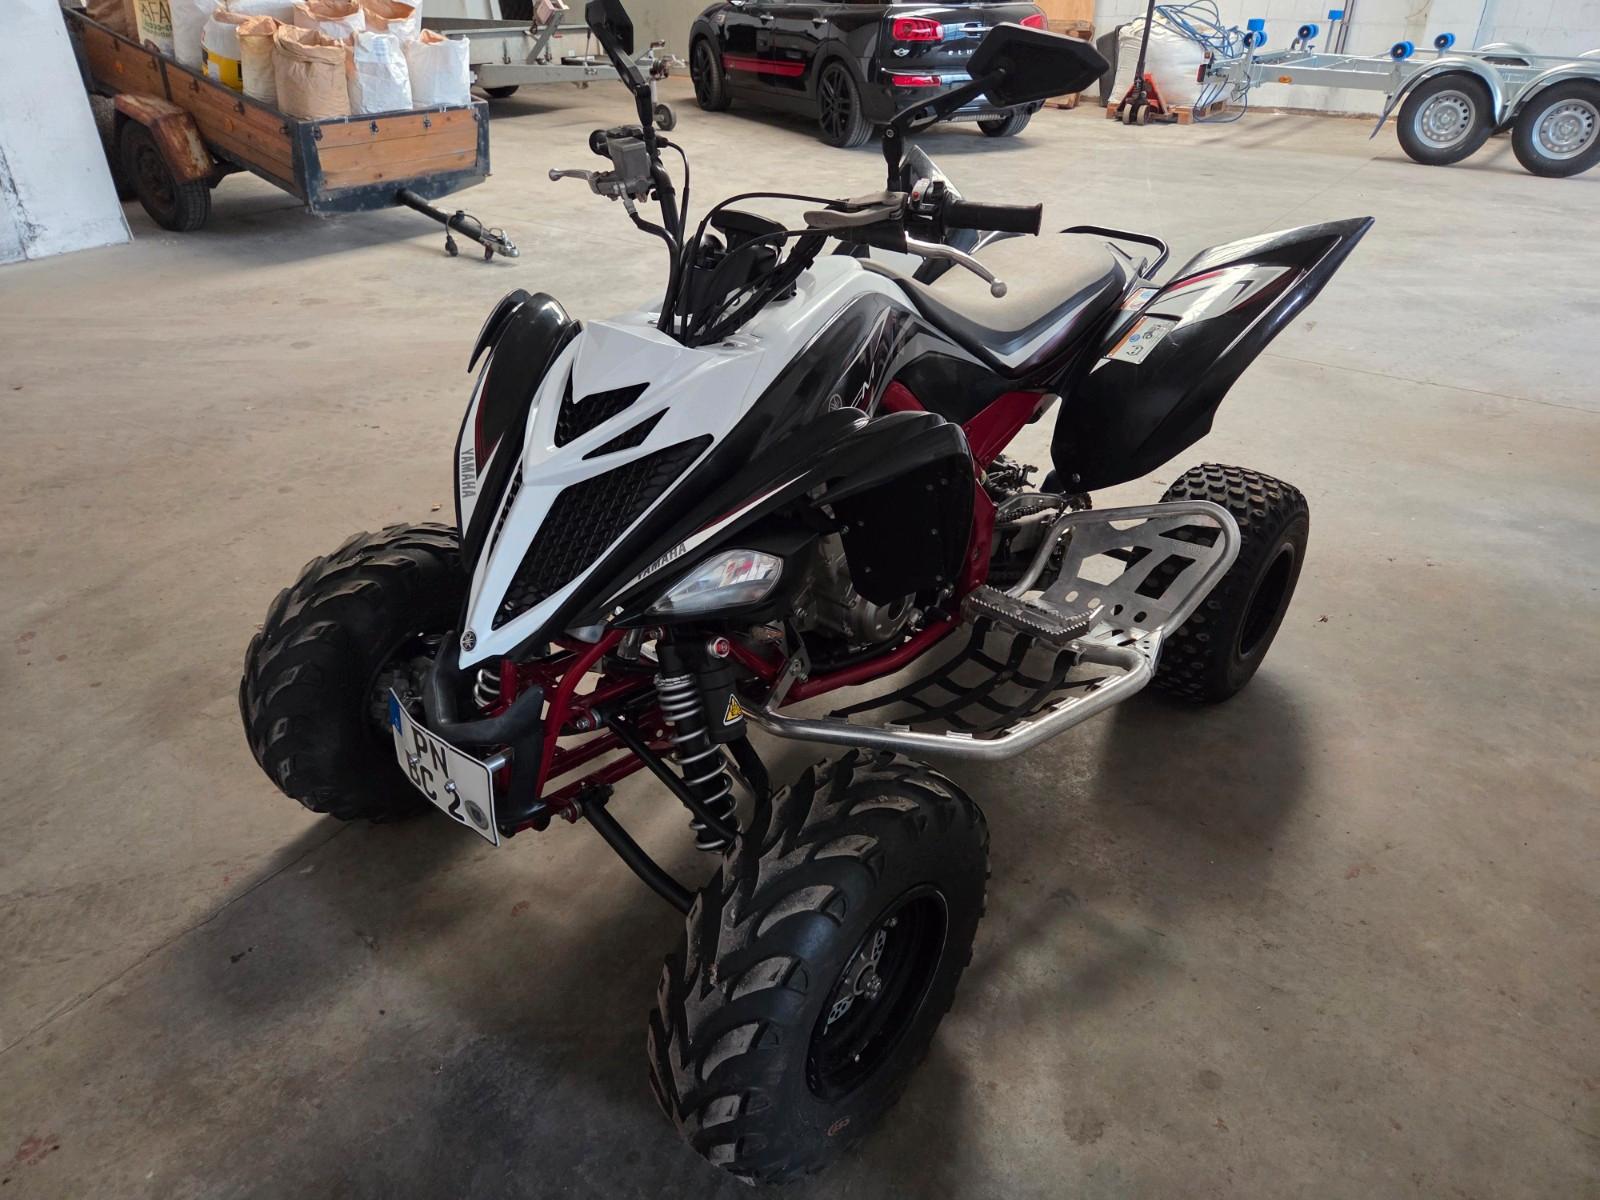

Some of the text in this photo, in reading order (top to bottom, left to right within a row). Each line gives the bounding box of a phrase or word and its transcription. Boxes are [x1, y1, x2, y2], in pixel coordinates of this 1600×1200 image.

[461, 447, 476, 498] YAMAHA
[638, 542, 687, 580] YAMAHA
[411, 725, 450, 779] PN
